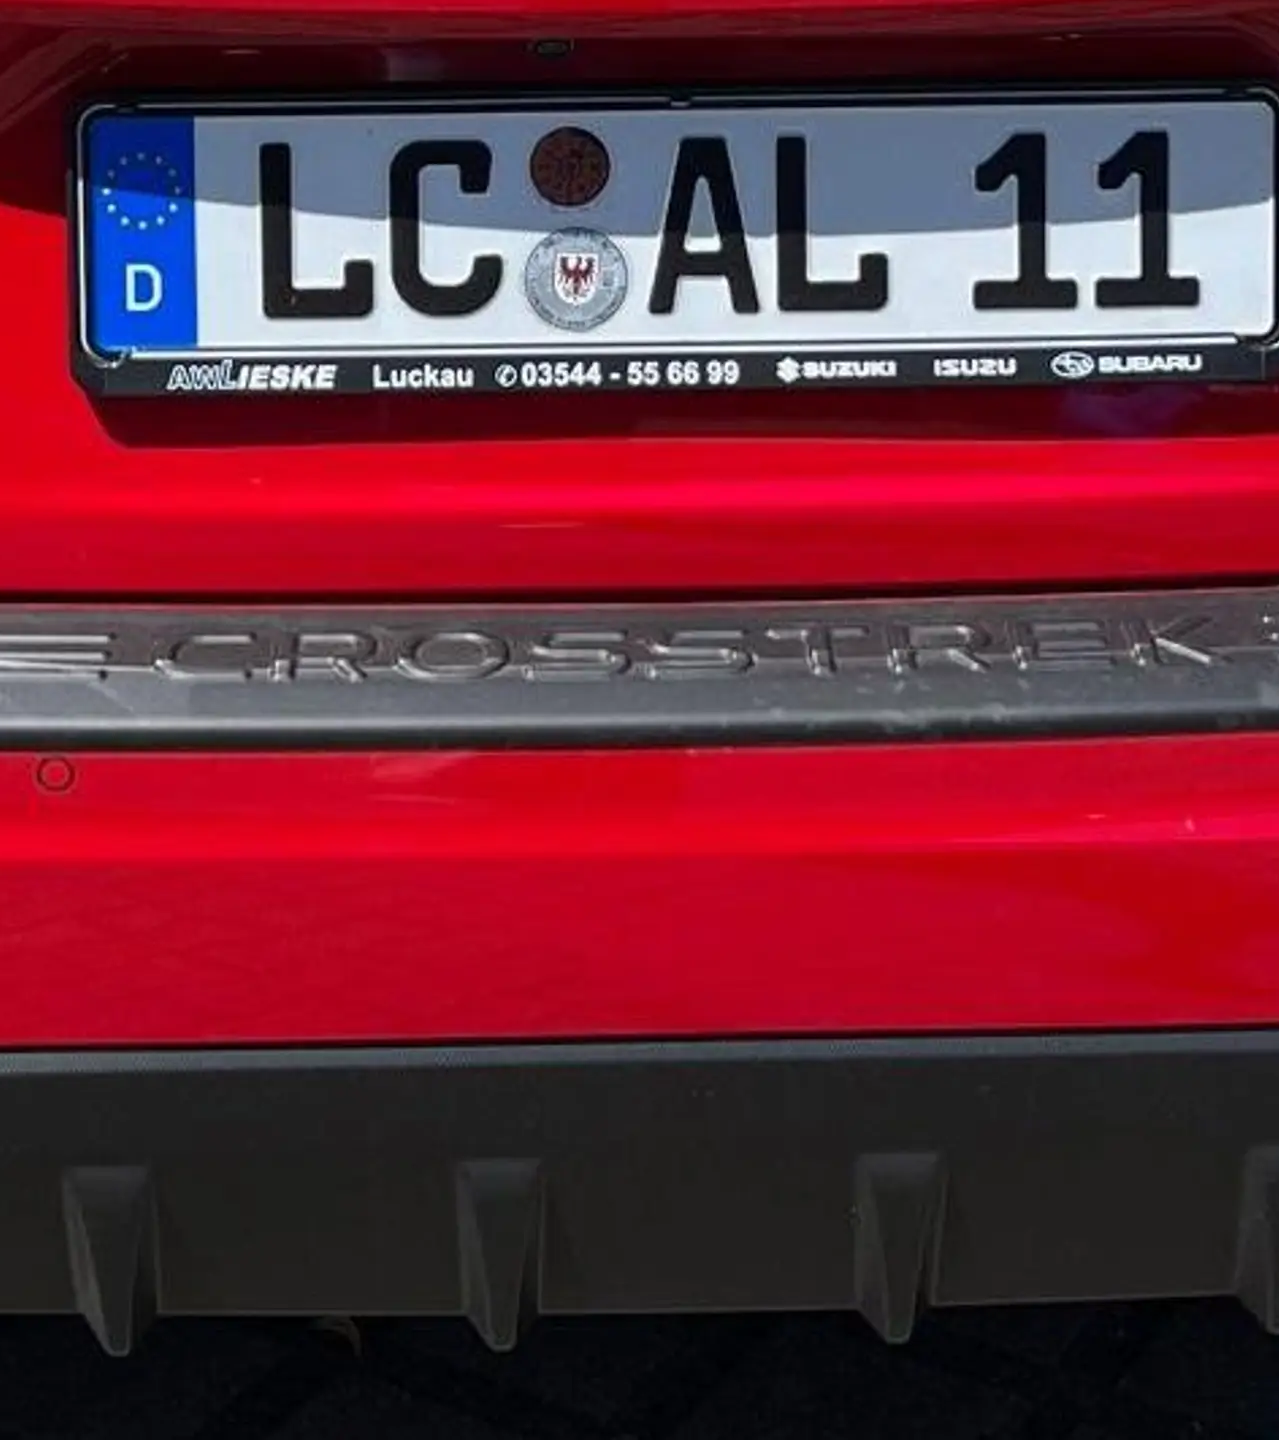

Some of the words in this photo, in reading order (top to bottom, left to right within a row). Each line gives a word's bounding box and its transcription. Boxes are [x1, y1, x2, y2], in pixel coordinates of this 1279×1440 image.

[258, 139, 504, 319] LC
[648, 134, 889, 314] AL
[973, 129, 1200, 310] 11
[126, 263, 163, 312] D
[372, 363, 475, 389] Luckau
[521, 361, 602, 388] 03544
[627, 361, 661, 386] 55
[666, 360, 701, 385] 66
[706, 359, 740, 385] 99
[802, 360, 897, 379] SUZUKI
[933, 357, 1017, 378] ISUZU
[1098, 353, 1203, 374] SUBARU
[152, 613, 1232, 684] CROSSTREK
